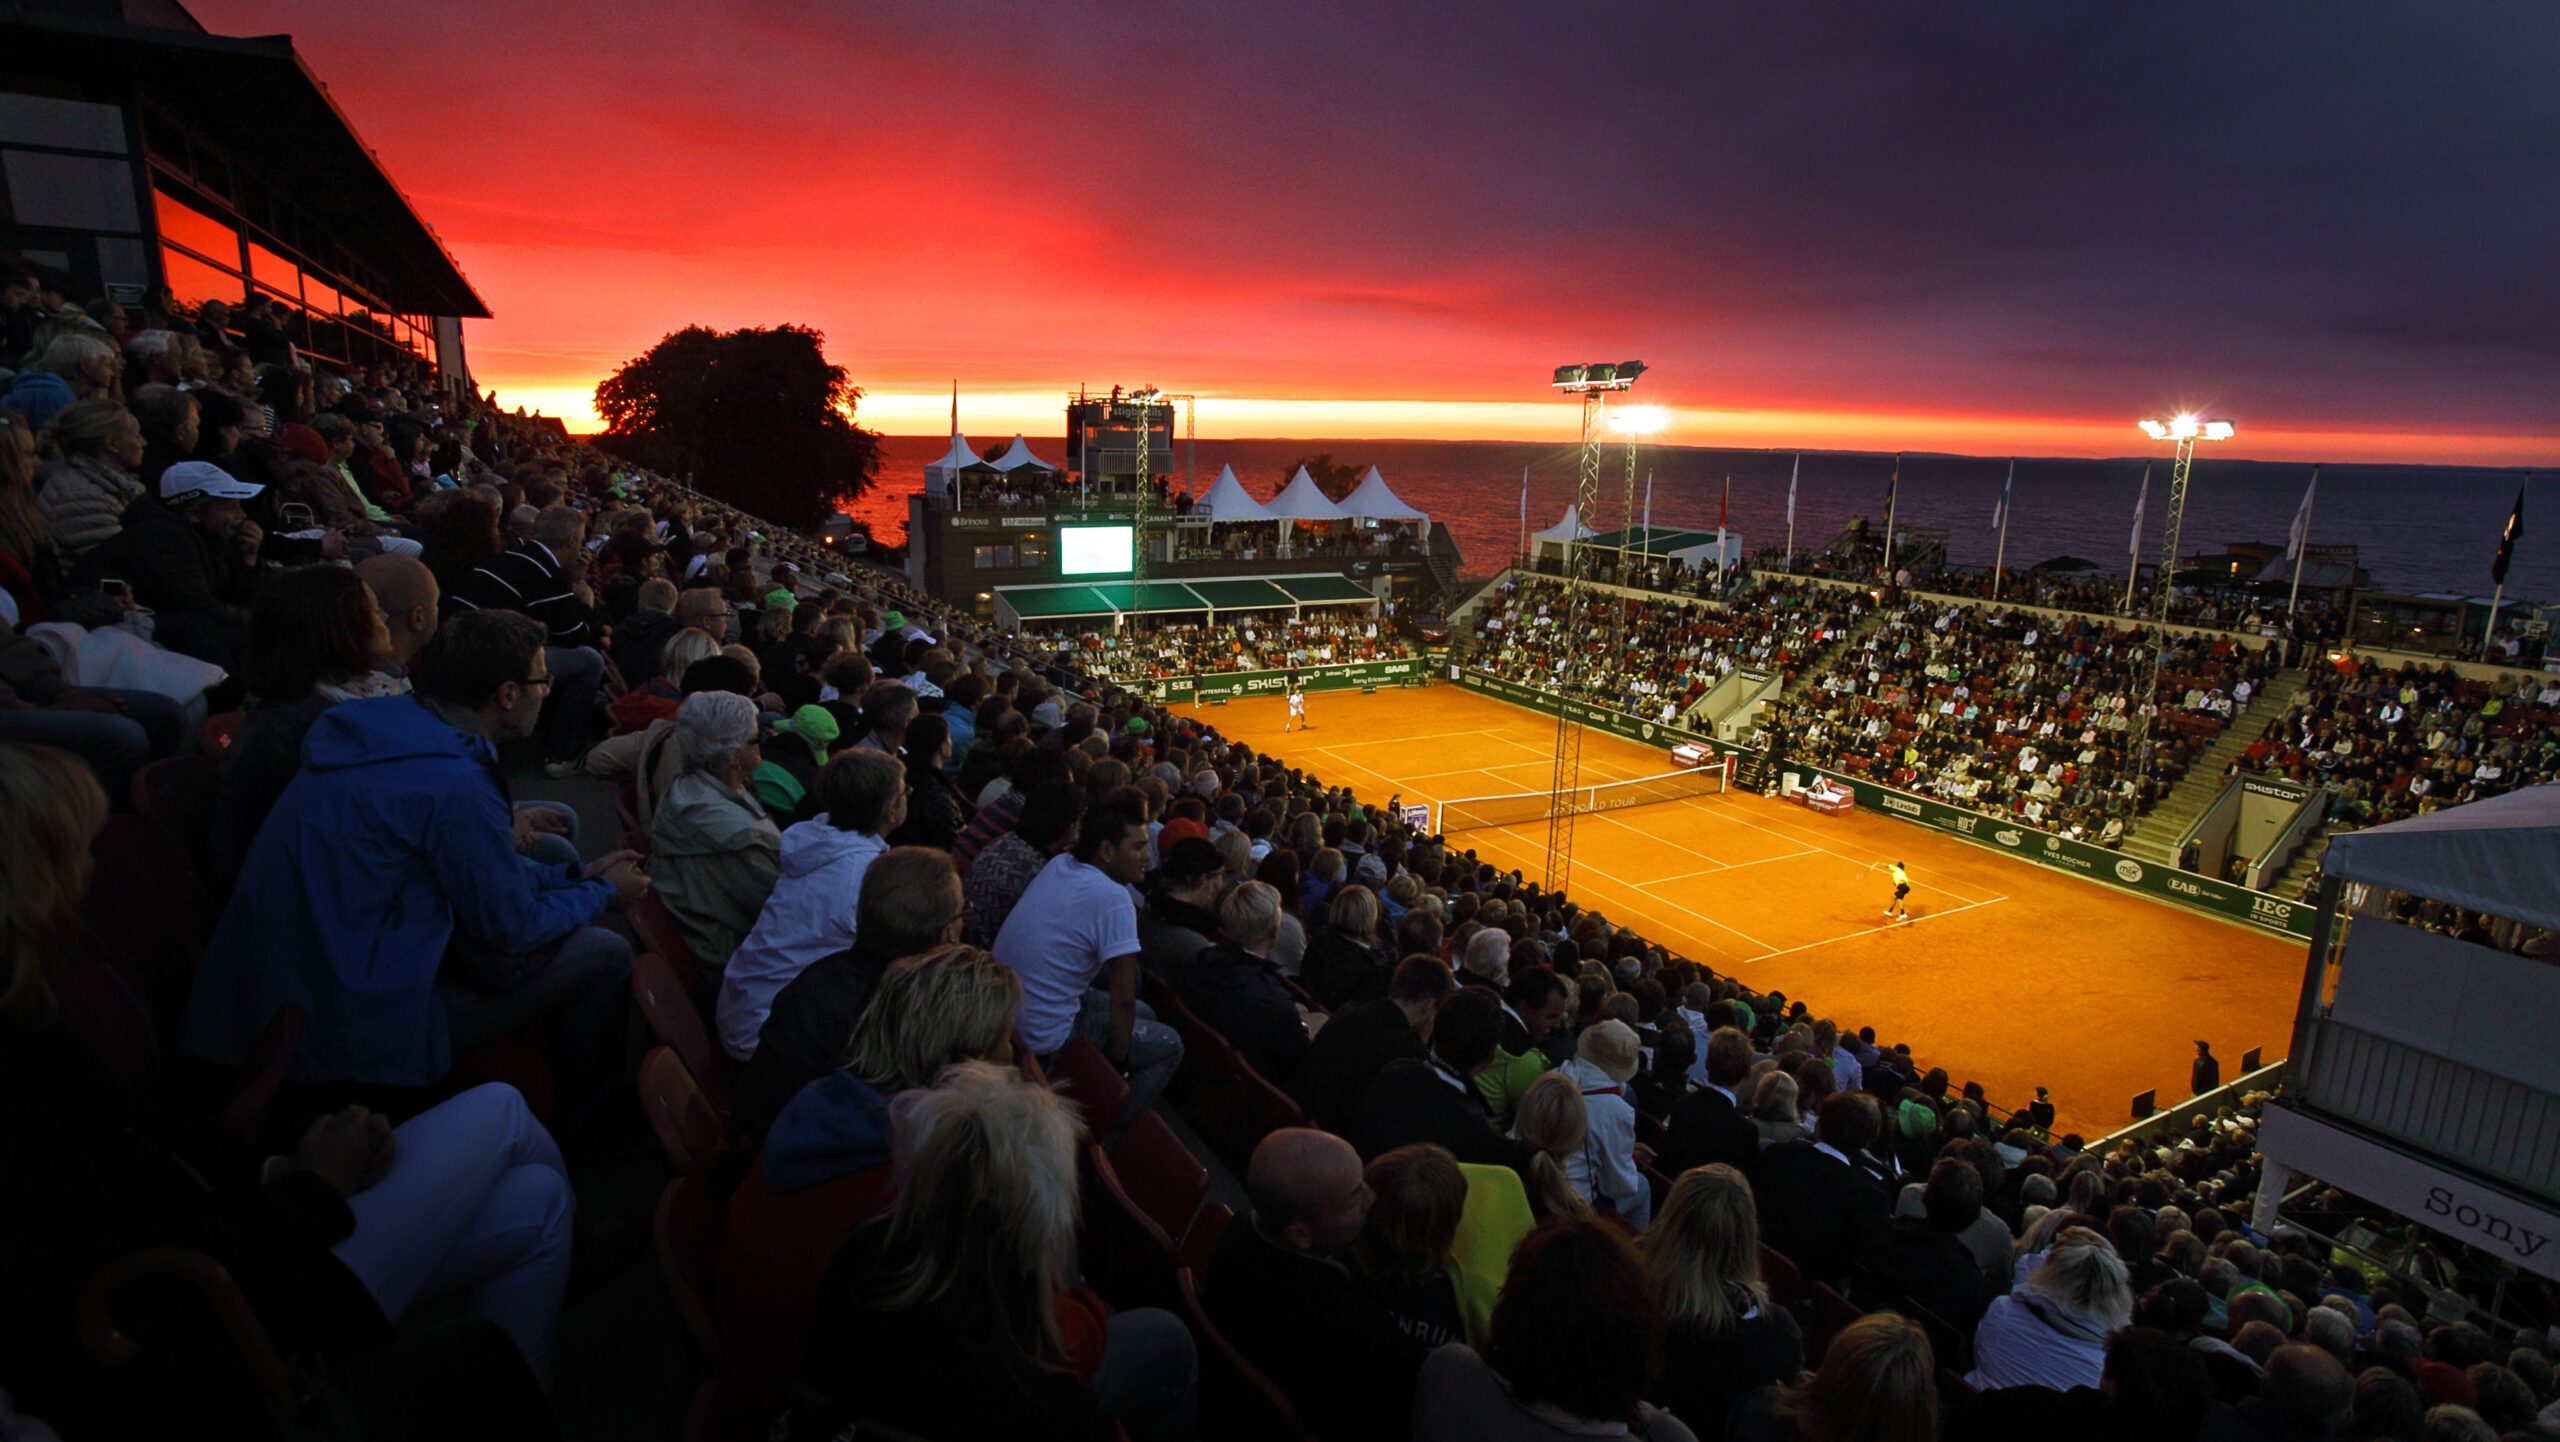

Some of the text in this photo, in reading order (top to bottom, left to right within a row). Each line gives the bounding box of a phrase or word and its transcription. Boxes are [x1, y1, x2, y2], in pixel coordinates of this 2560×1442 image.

[960, 516, 989, 526] Brinova
[1384, 665, 1410, 674] SAAB
[1609, 796, 1637, 808] TOUR
[1896, 799, 1919, 813] Lindab
[2043, 849, 2092, 869] YVES ROCHER
[2171, 879, 2198, 895] EAB
[2252, 896, 2291, 918] IEC
[2259, 915, 2288, 928] SPORTS
[2425, 1187, 2553, 1257] Sony
